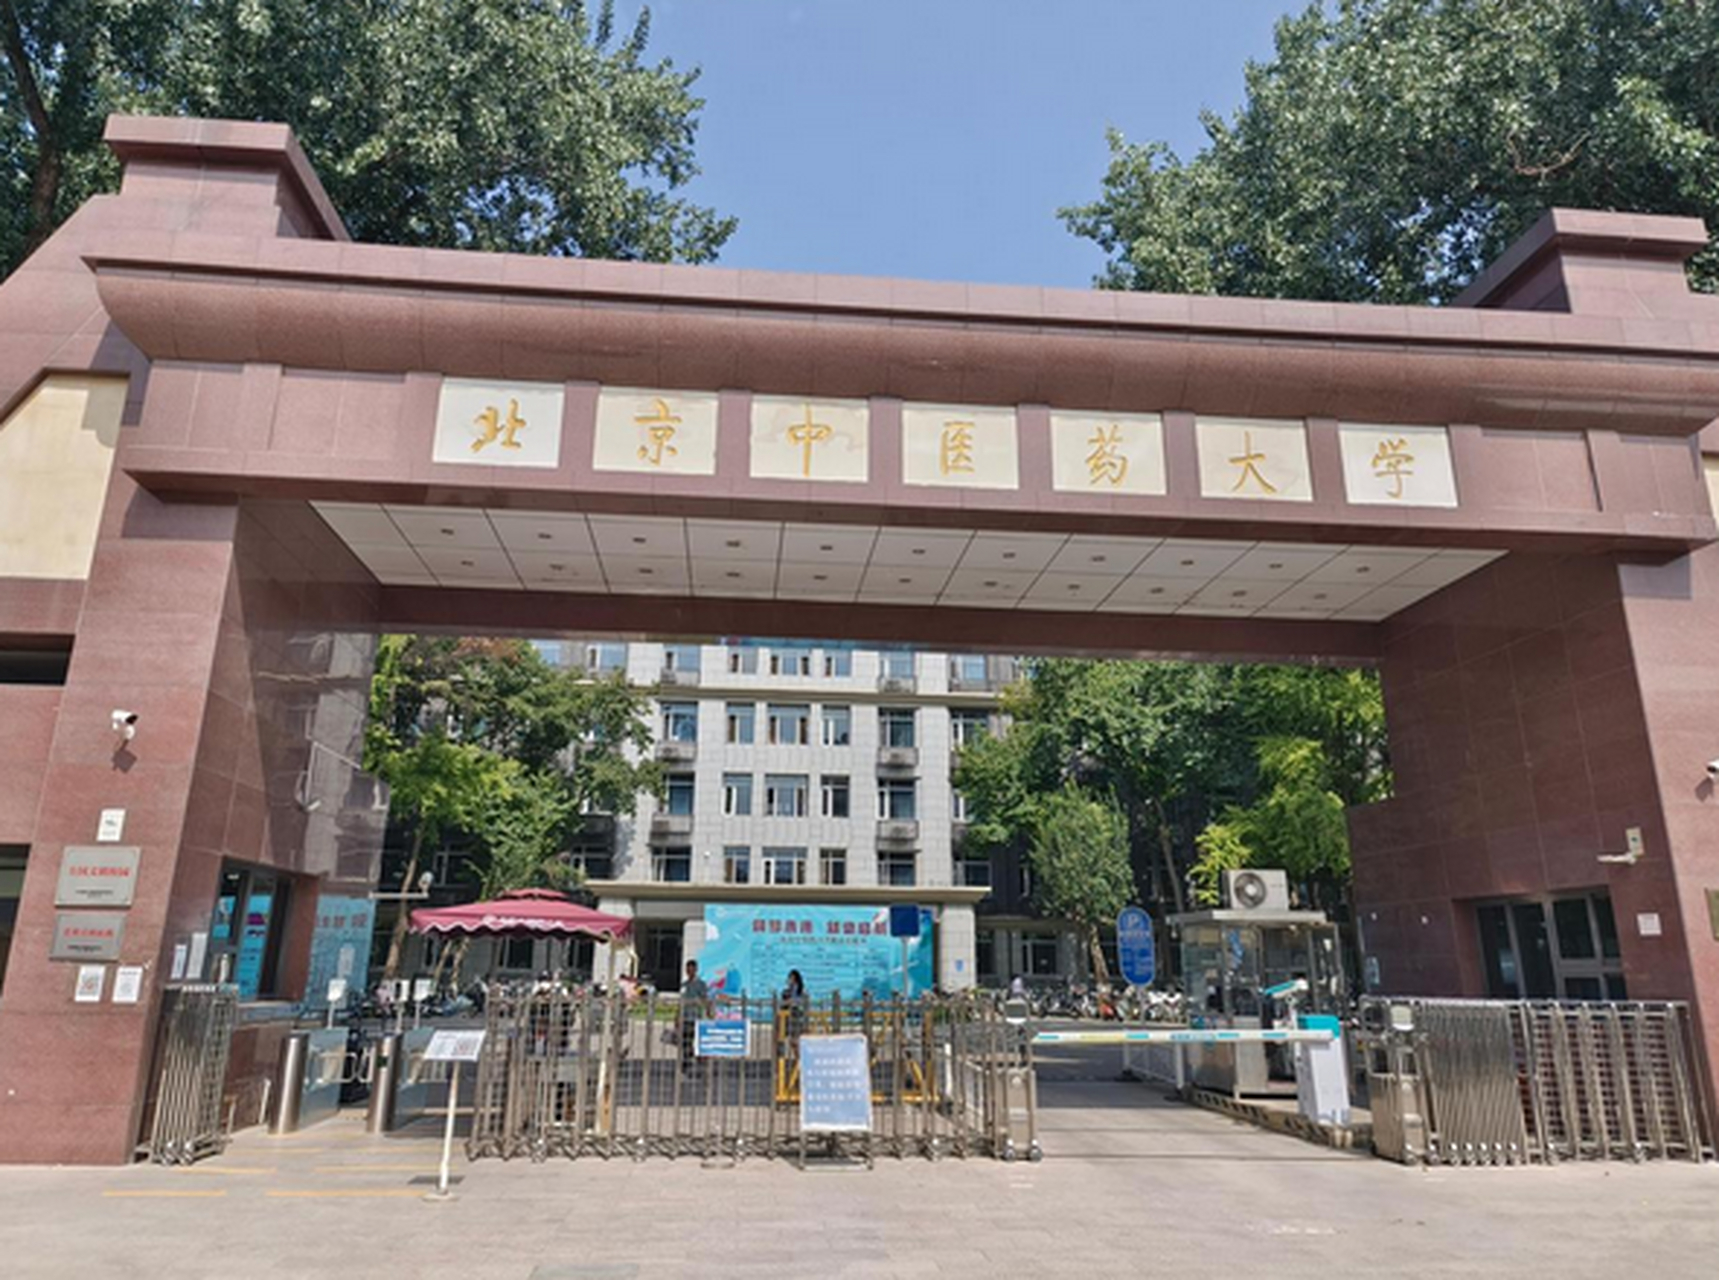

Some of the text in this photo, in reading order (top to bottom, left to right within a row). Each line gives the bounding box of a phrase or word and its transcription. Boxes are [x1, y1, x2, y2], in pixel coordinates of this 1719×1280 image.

[470, 397, 1416, 499] 北京中医药大学
